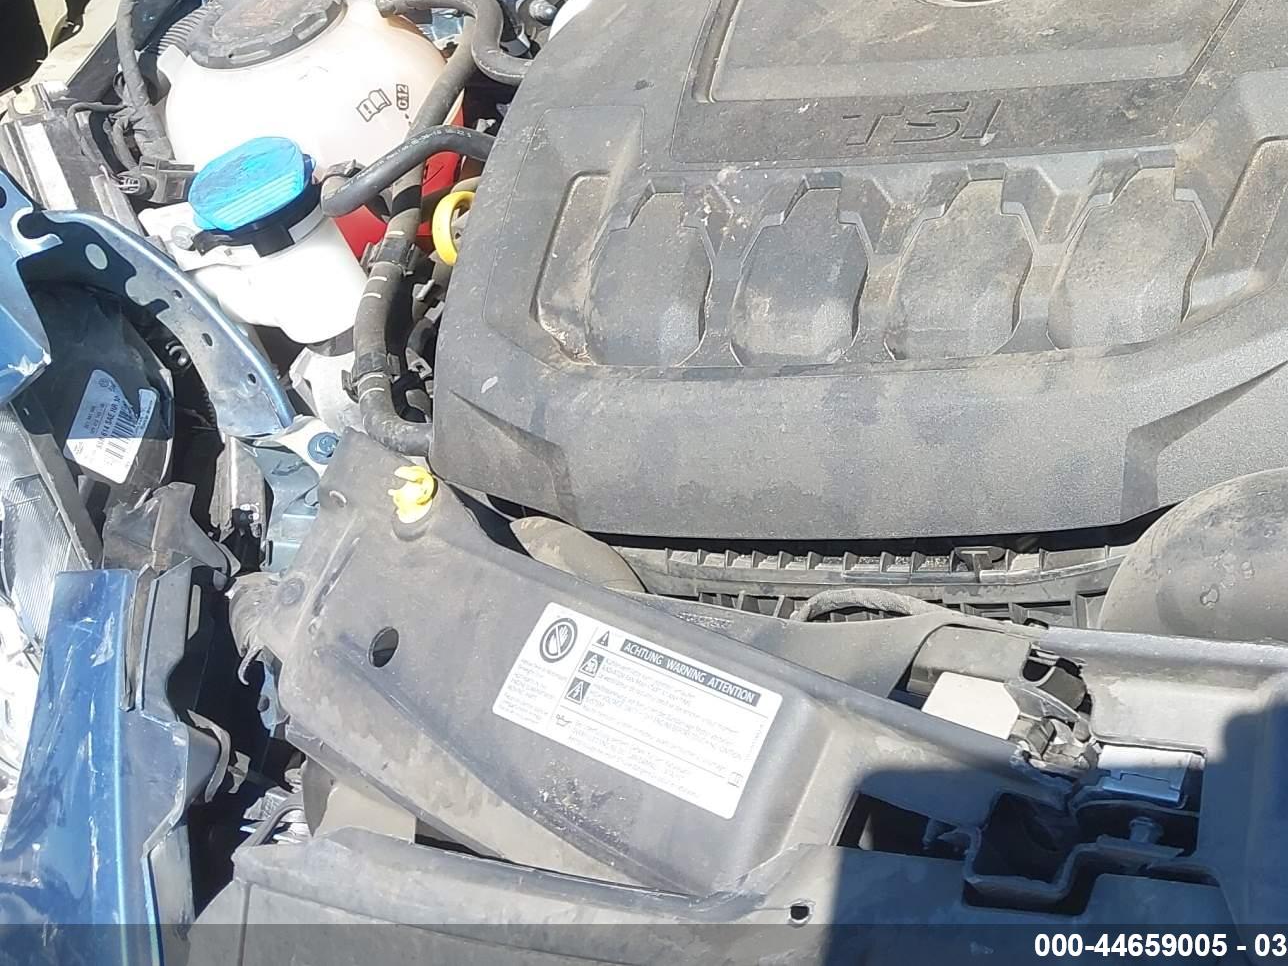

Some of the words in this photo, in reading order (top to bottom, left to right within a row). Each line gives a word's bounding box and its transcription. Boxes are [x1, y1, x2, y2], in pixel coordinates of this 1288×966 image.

[841, 98, 1003, 147] TSI
[623, 642, 664, 666] ACHTUNG
[666, 659, 708, 684] WARNING
[707, 677, 757, 705] ATTENTION
